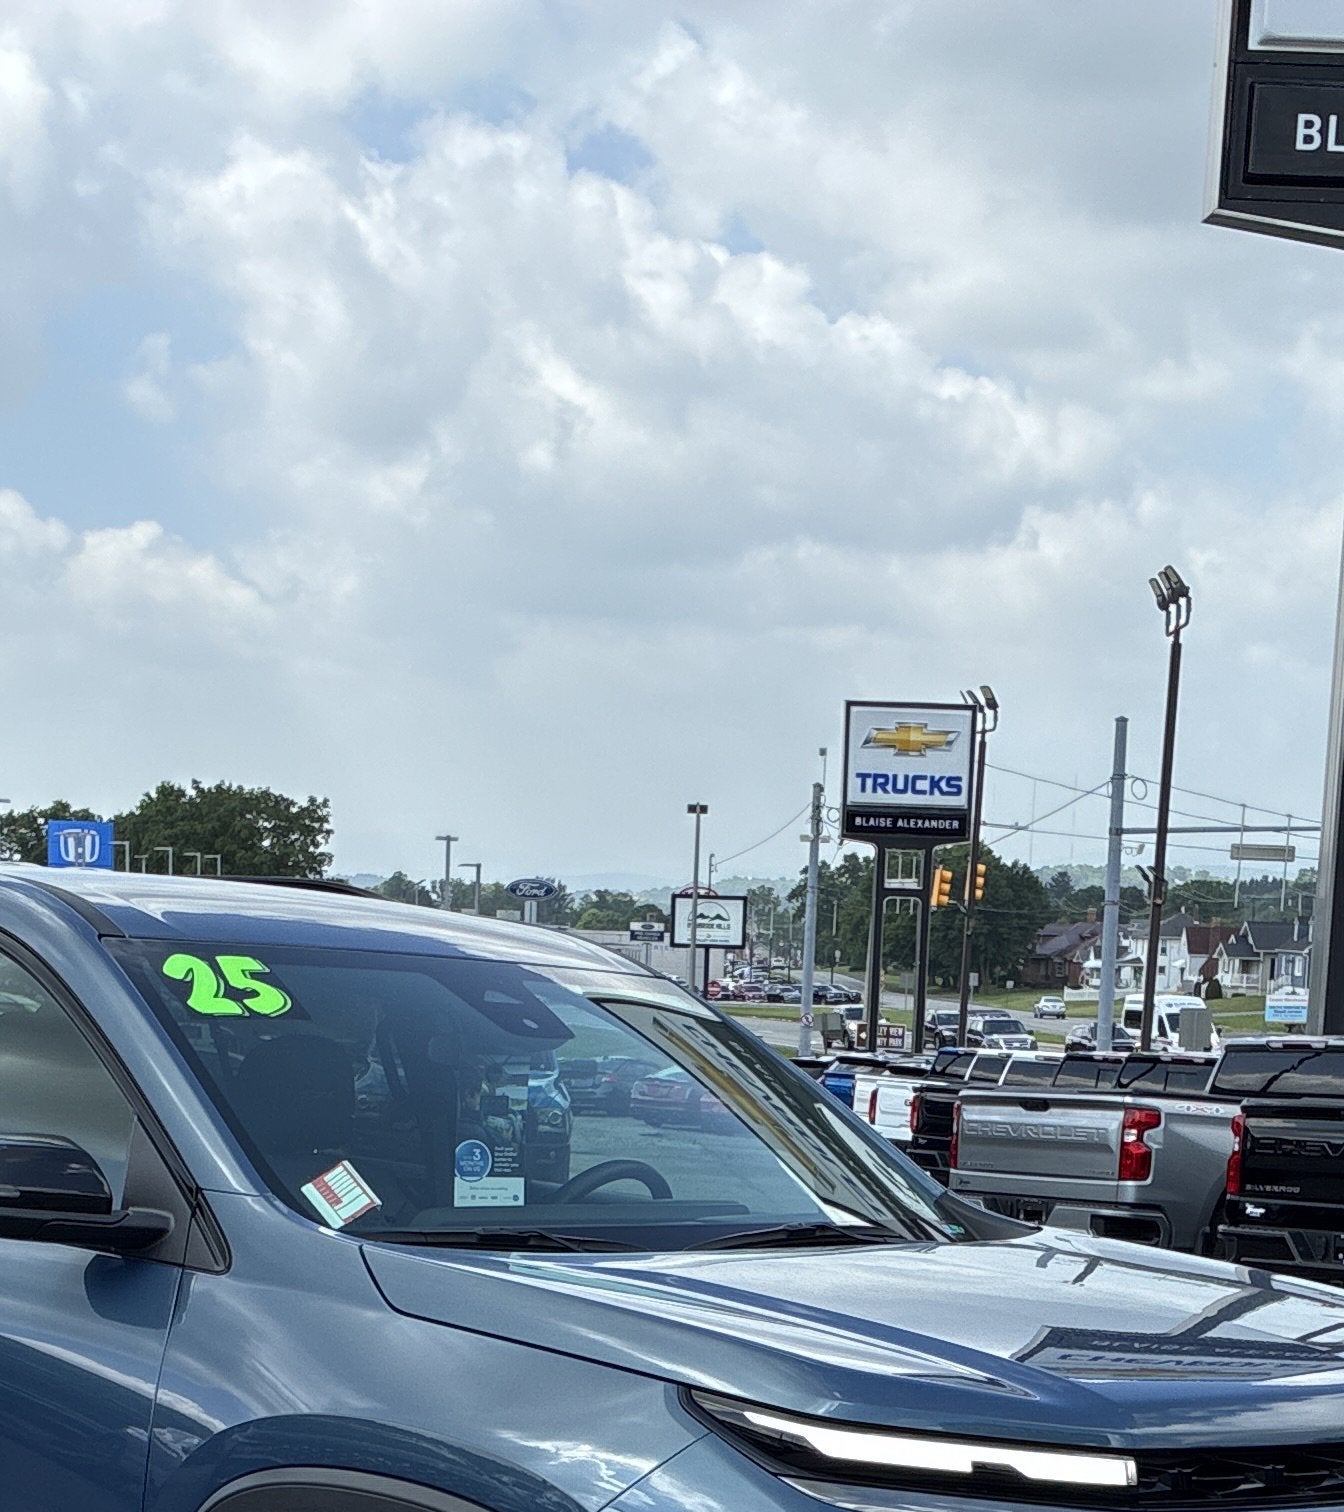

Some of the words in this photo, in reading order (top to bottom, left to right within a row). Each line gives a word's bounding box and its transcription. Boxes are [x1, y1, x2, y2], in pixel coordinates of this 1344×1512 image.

[855, 772, 963, 796] TRUCKS
[855, 816, 893, 827] BLAISE
[896, 818, 960, 830] ALEXANDER
[516, 883, 546, 897] Ford
[162, 953, 292, 1017] 25
[964, 1122, 1106, 1141] CHEVROLET
[472, 1149, 481, 1161] 3
